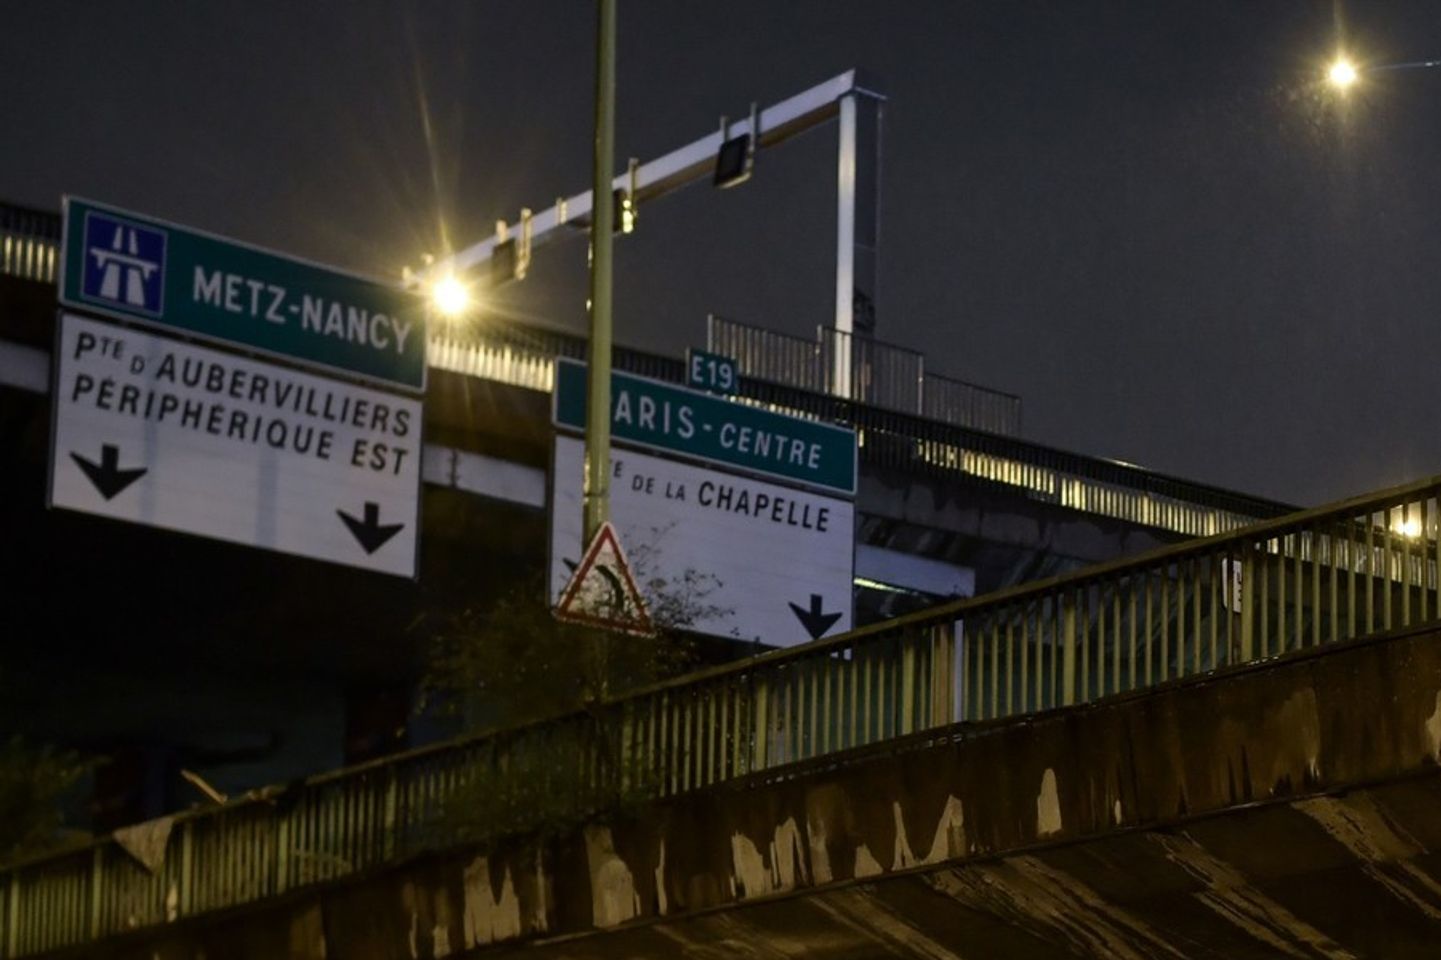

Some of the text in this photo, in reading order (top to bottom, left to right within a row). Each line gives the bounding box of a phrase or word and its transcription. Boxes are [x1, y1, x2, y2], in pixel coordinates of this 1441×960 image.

[193, 265, 413, 353] METZ-NANCY
[155, 353, 410, 437] AUBERVILLIERS
[691, 356, 734, 389] E19
[351, 439, 409, 475] EST
[614, 390, 822, 469] ARIS-CENTRE
[632, 474, 830, 532] DE LA CHAPELLE
